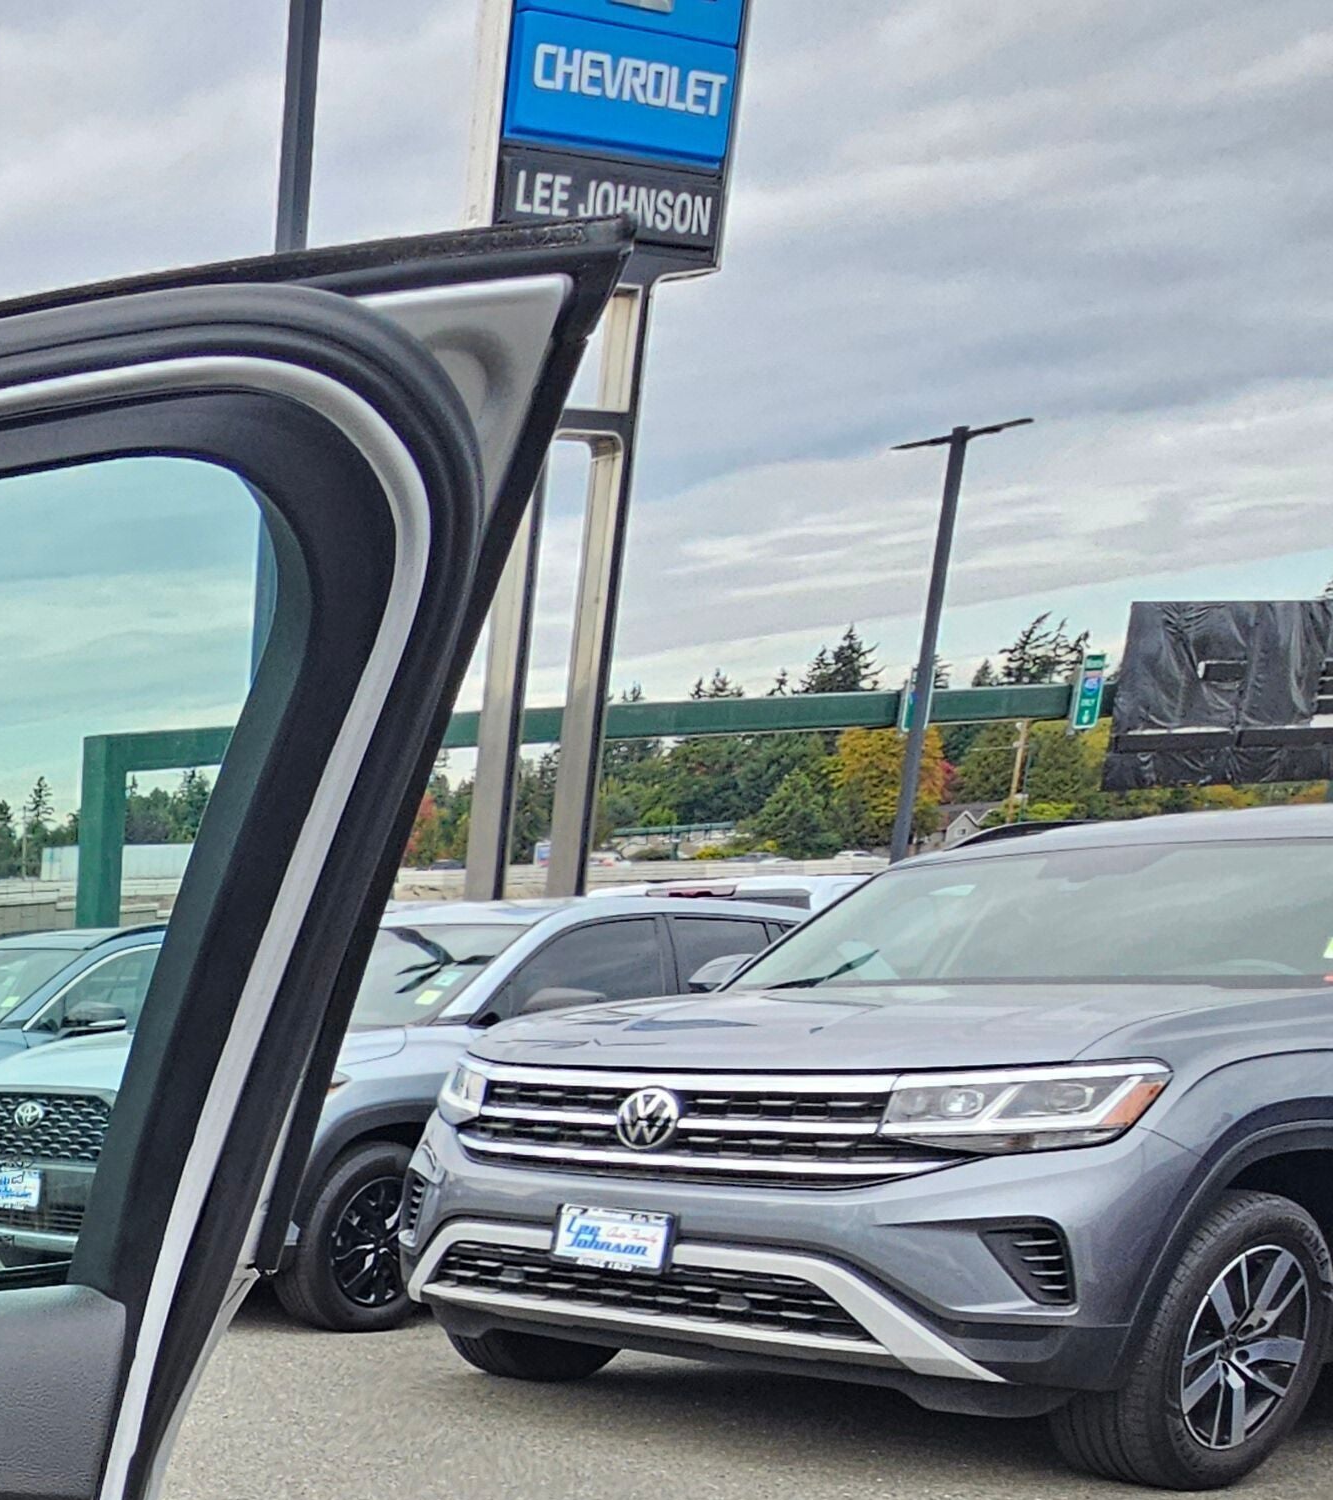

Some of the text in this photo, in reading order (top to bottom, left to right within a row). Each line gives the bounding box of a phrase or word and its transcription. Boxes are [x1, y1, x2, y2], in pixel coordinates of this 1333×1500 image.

[533, 42, 729, 118] CHEVROLET
[514, 169, 713, 237] LEE JOHNSON
